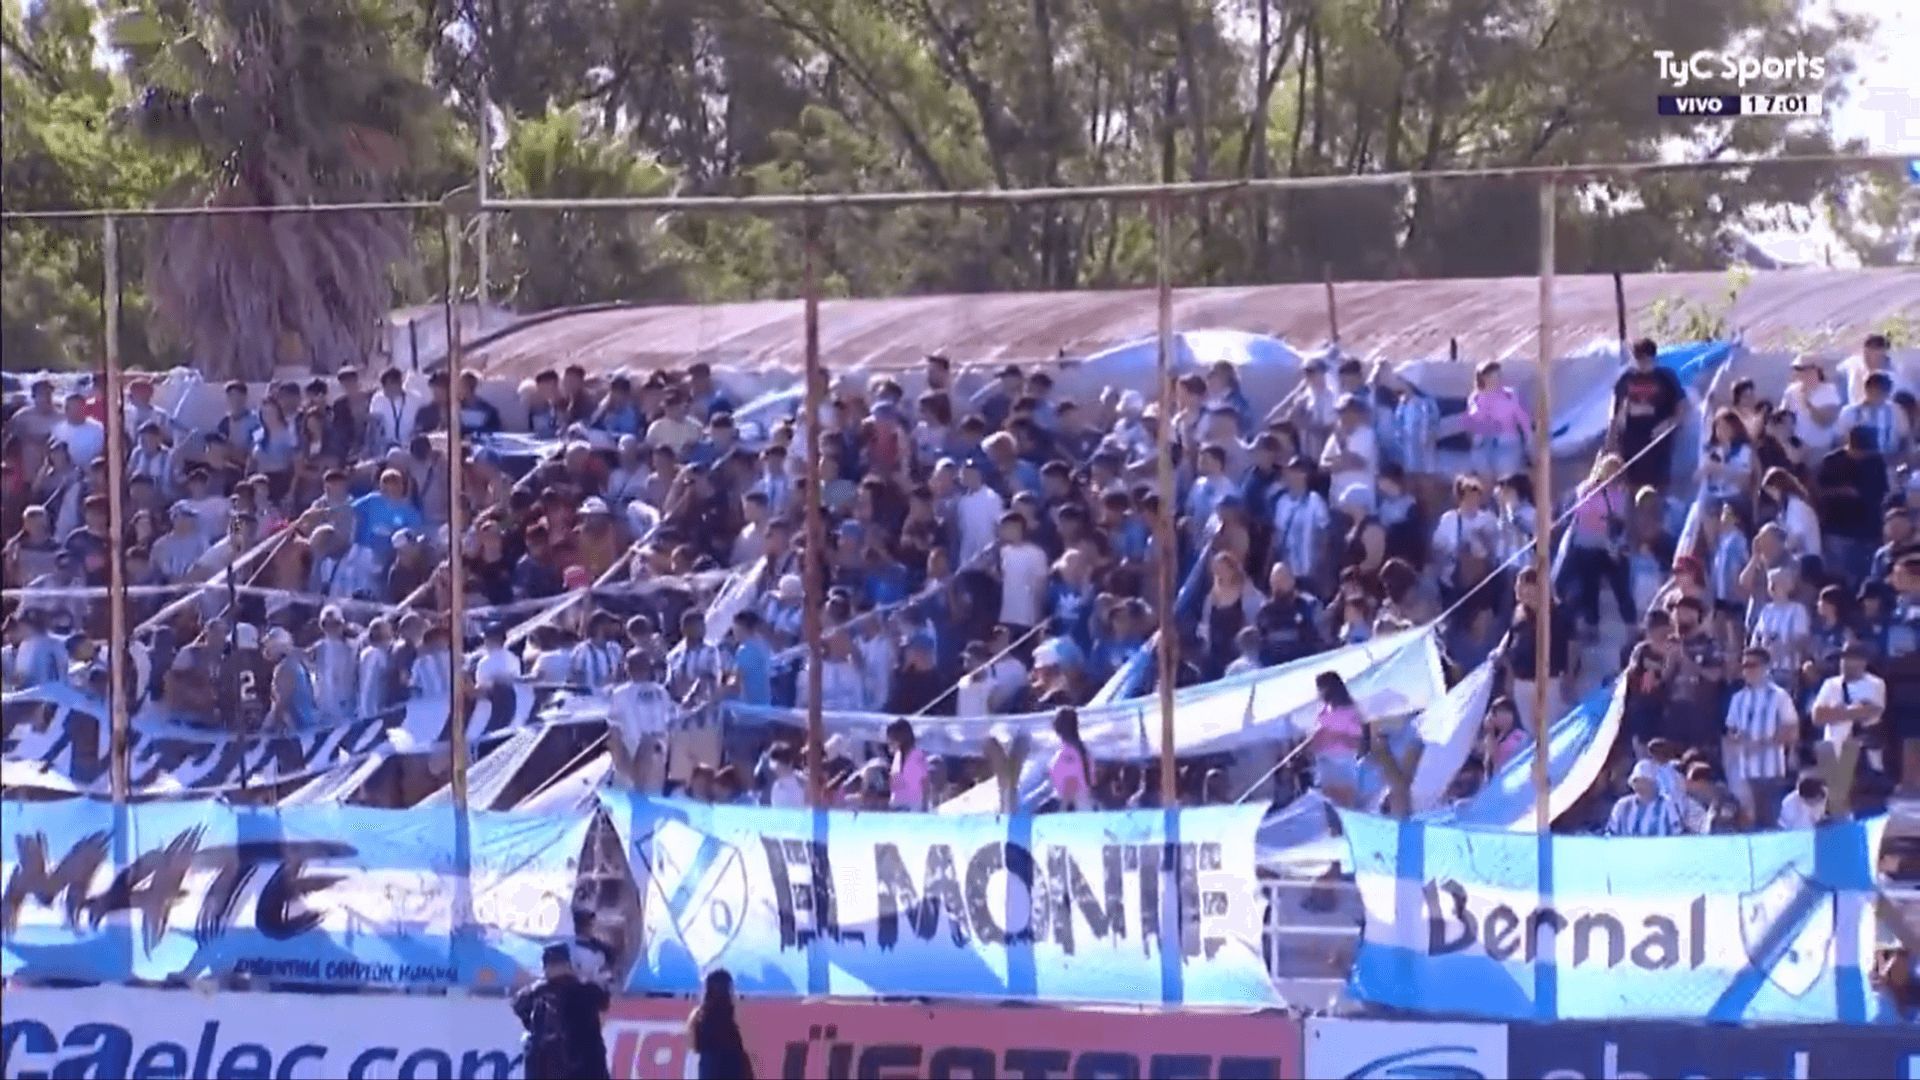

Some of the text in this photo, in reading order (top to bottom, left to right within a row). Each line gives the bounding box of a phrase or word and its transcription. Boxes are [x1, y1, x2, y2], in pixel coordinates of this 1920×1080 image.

[763, 836, 1229, 964] EL MONTE
[1422, 878, 1707, 970] Bernal
